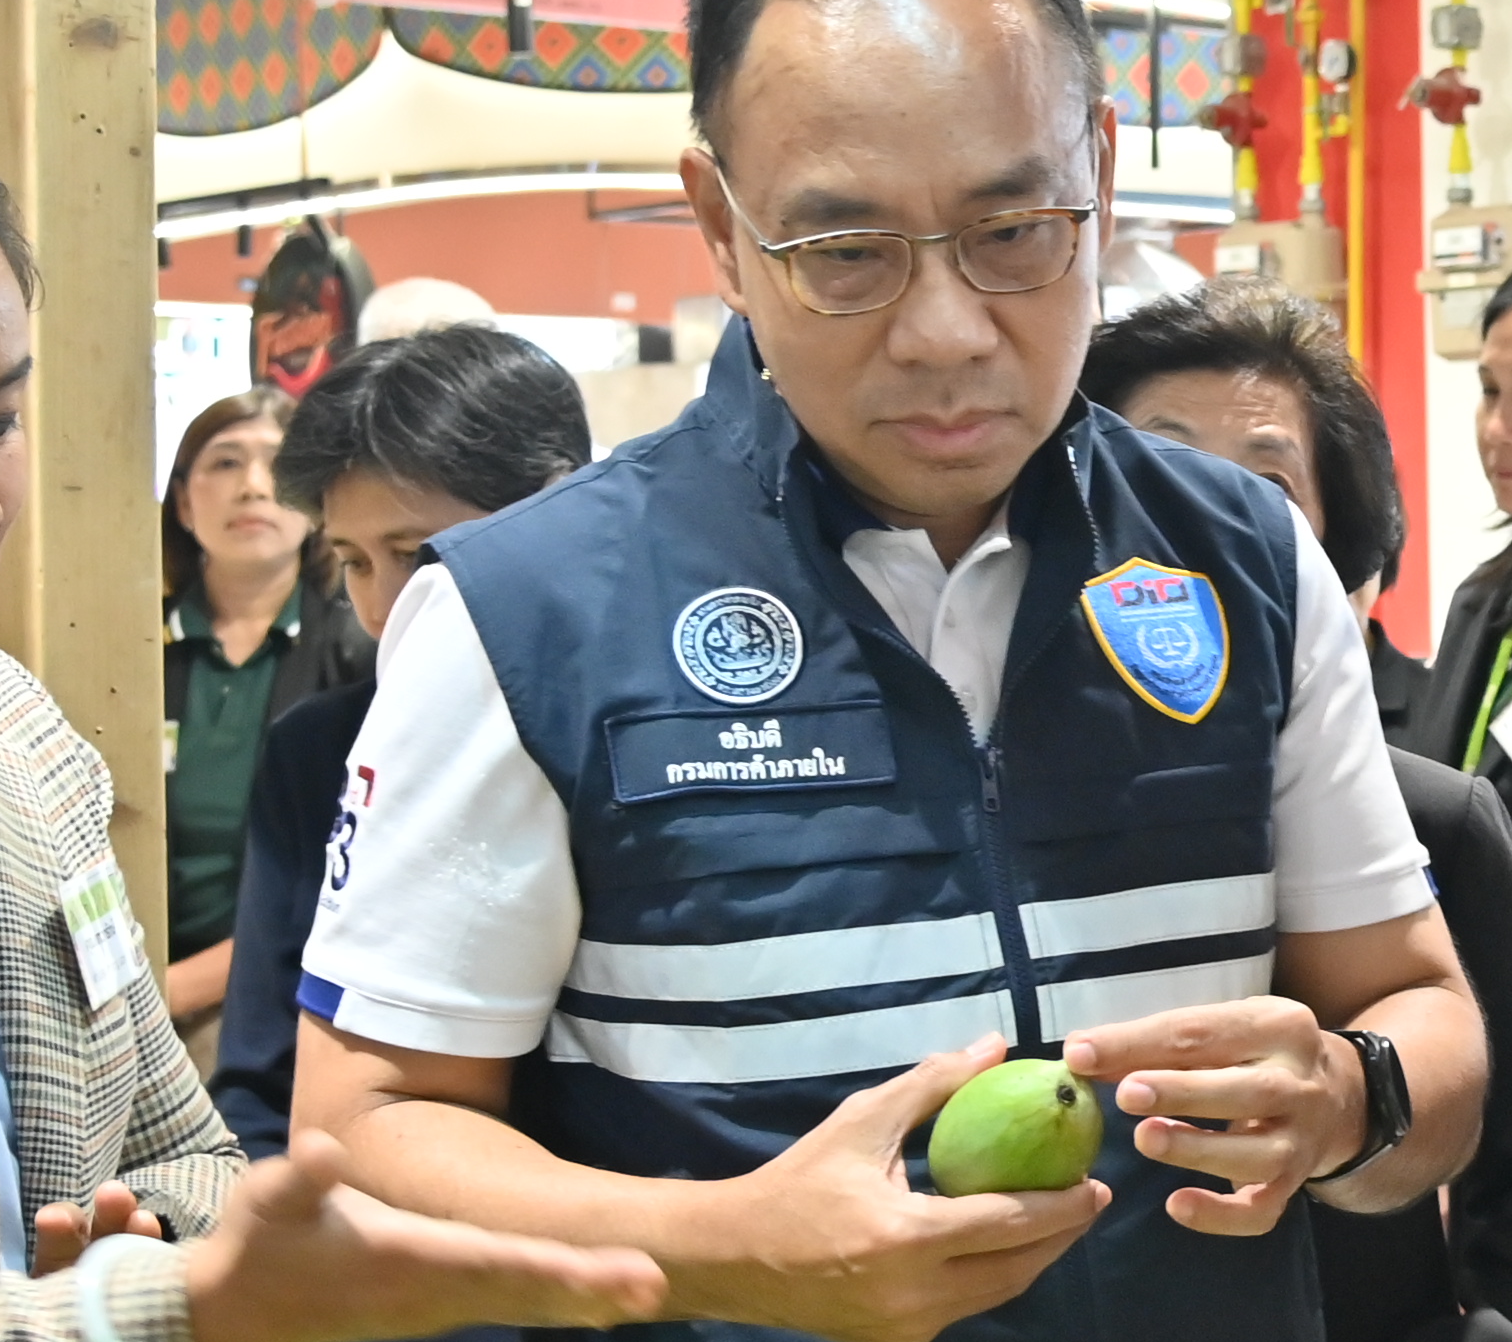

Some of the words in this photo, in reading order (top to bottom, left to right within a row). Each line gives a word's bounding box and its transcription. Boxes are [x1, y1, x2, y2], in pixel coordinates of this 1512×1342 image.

[718, 719, 782, 749] อธิบดี
[666, 747, 846, 783] กรมการค้าภายใน
